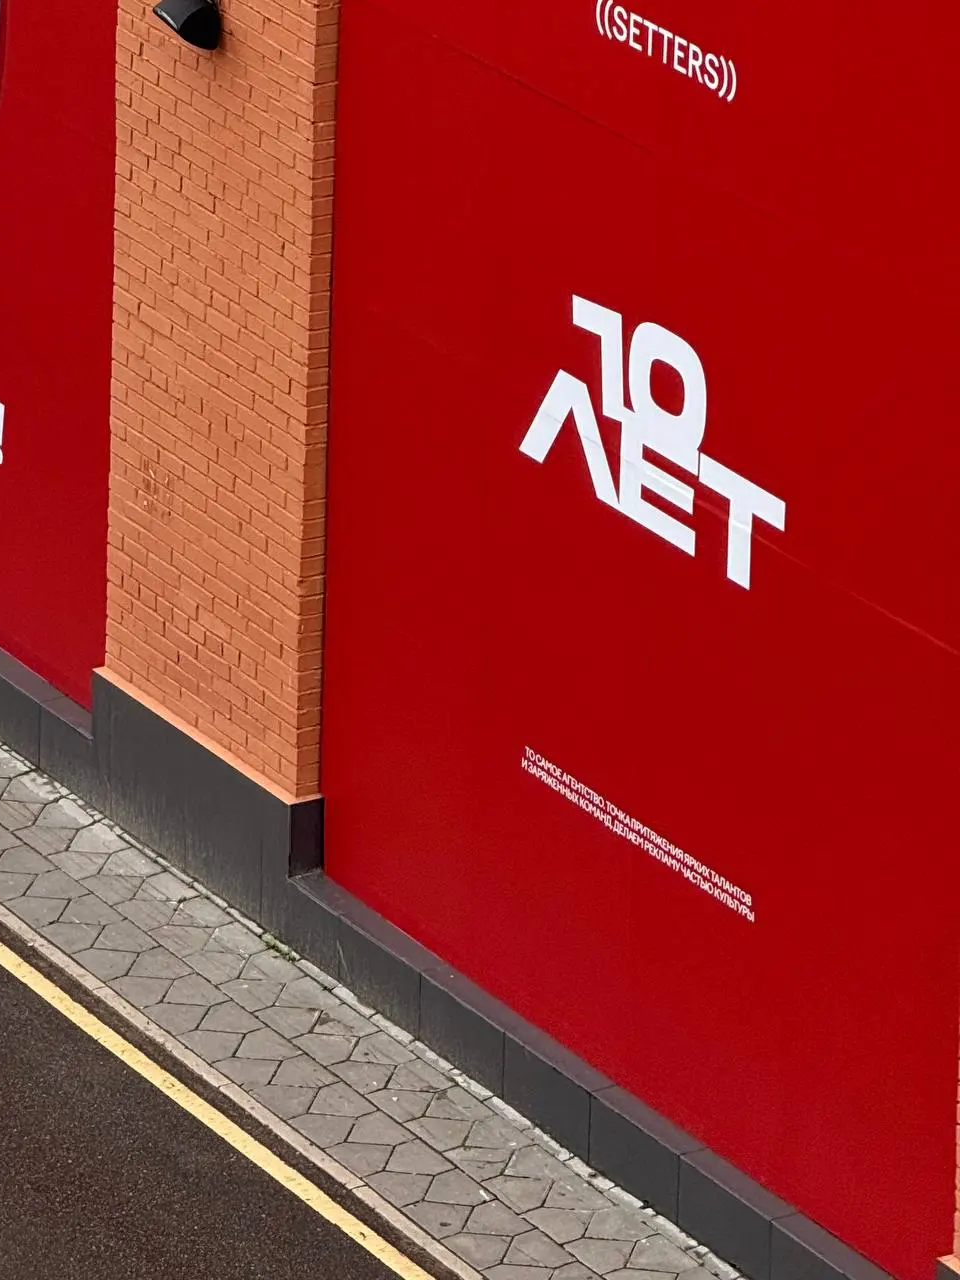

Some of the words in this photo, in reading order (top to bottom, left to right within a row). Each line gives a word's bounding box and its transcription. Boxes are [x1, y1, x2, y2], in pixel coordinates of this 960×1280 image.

[572, 294, 707, 465] 10
[518, 368, 786, 591] ЛЕТ
[521, 756, 527, 769] И
[527, 760, 579, 804] ЗАРЯЖЕННЫХ
[613, 818, 643, 847] ДЕЛАЕМ
[644, 839, 680, 872] РЕКЛАМУ
[681, 863, 713, 893] ЧАСТЬЮ
[714, 885, 754, 921] КУЛЬТУРЫ
[525, 745, 535, 761] ТО
[535, 752, 561, 778] САМОЕ
[605, 799, 630, 825] ТОЧКА
[630, 816, 683, 860] ПРИТЯЖЕНИЯ
[684, 851, 710, 878] ЯРКИХ
[711, 870, 751, 906] ТАЛАНТОВ
